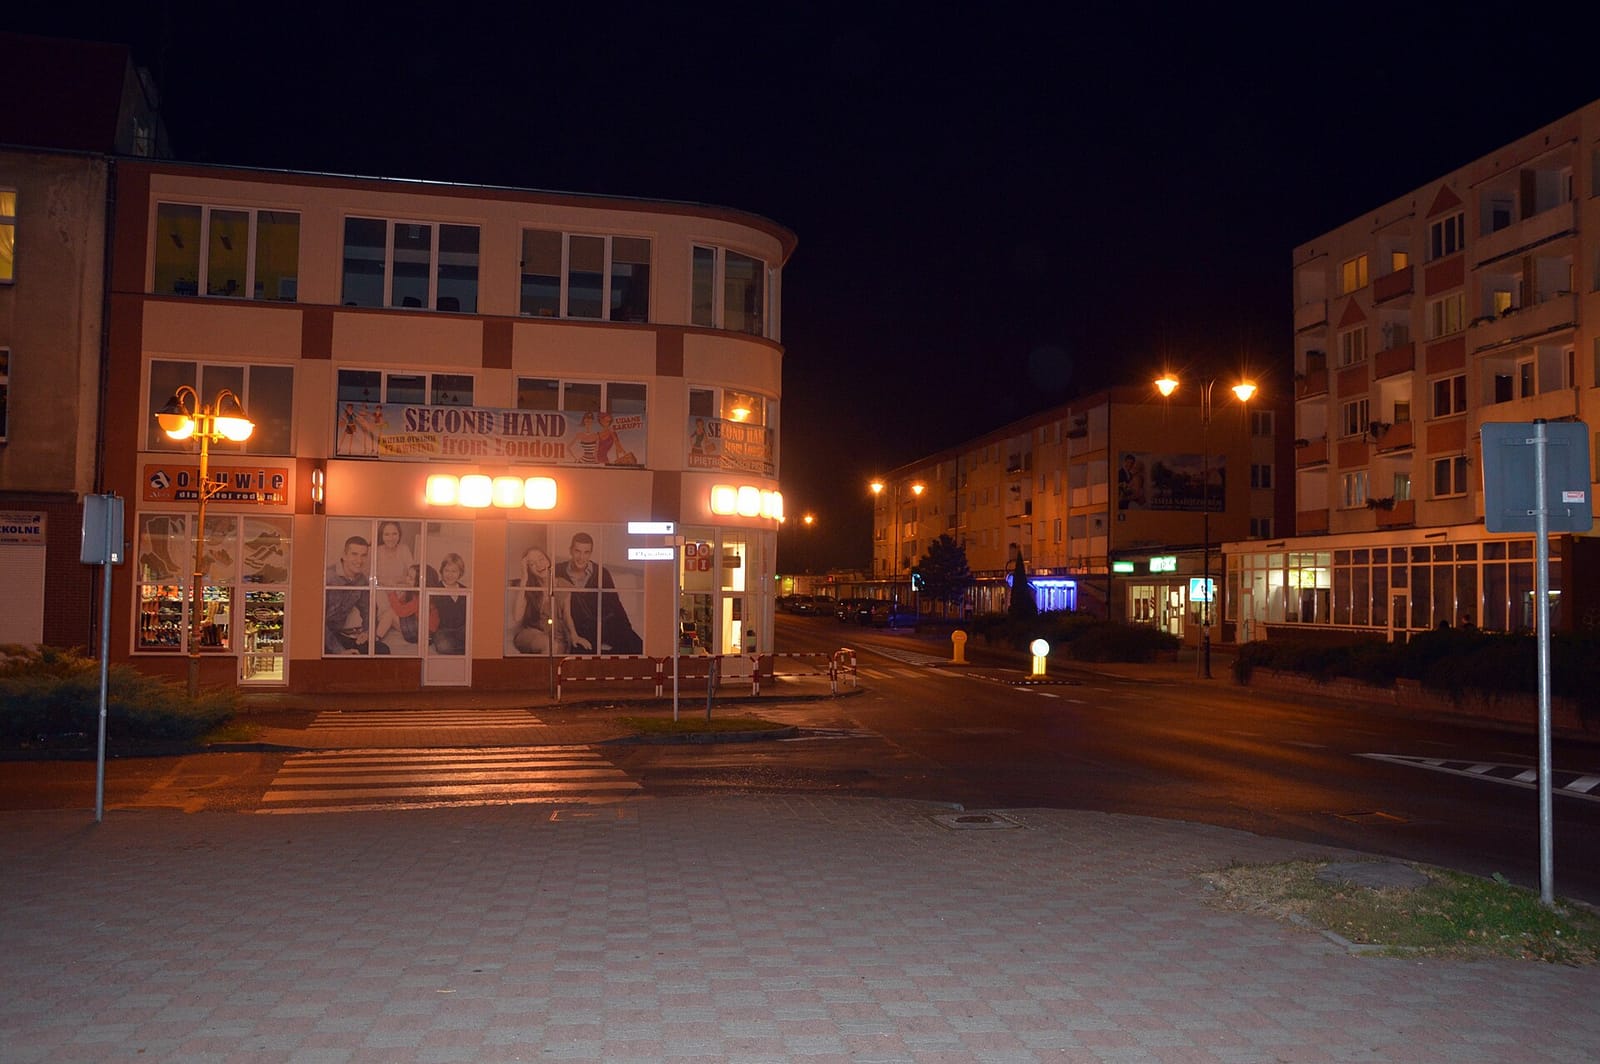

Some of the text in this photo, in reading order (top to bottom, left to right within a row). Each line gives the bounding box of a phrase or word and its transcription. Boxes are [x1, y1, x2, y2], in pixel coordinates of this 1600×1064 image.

[405, 407, 567, 438] SECOND HAND
[441, 436, 565, 459] from London
